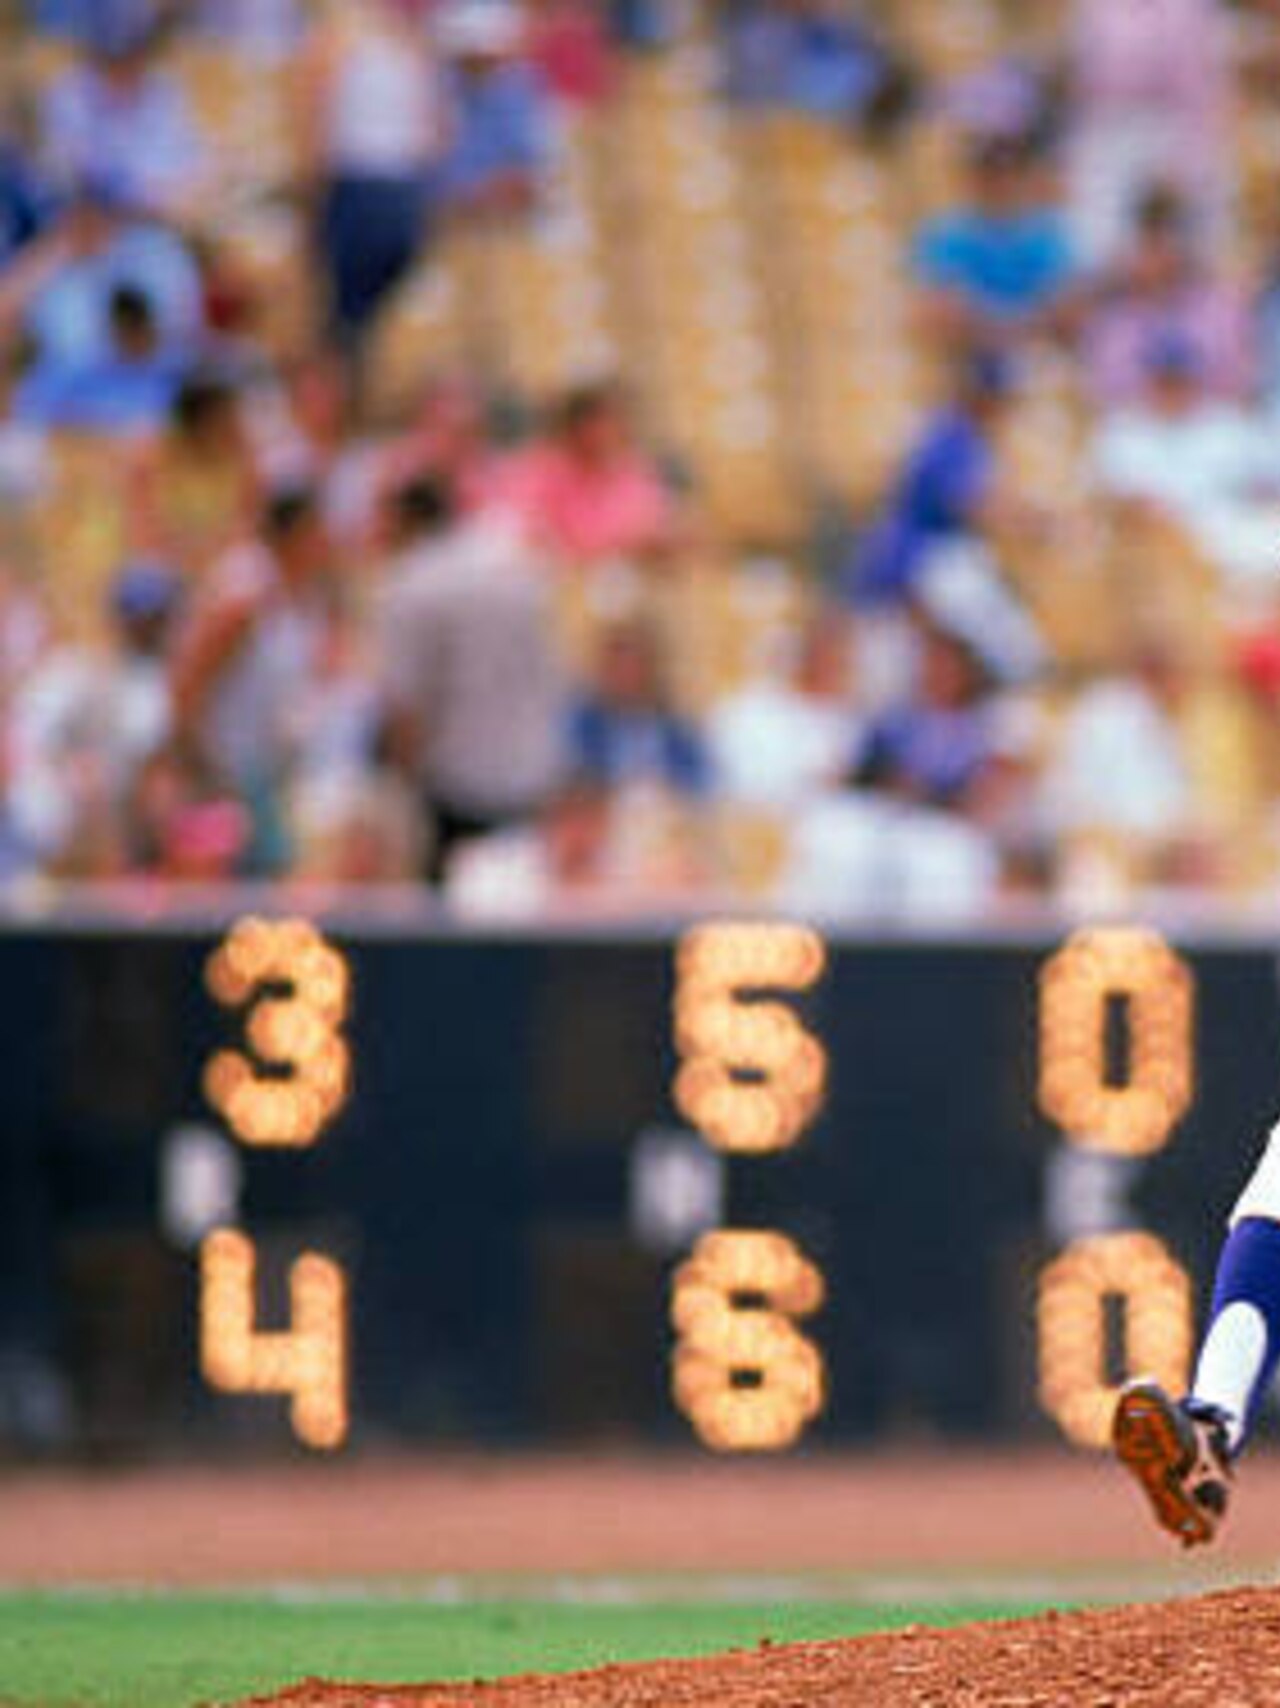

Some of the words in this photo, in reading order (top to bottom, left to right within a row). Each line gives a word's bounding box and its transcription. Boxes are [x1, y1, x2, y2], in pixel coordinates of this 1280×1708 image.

[205, 915, 350, 1147] 3
[674, 920, 826, 1153] 5
[1038, 925, 1195, 1158] 0
[200, 1228, 348, 1450] 4
[673, 1230, 825, 1452] 6
[1037, 1231, 1194, 1450] 0
